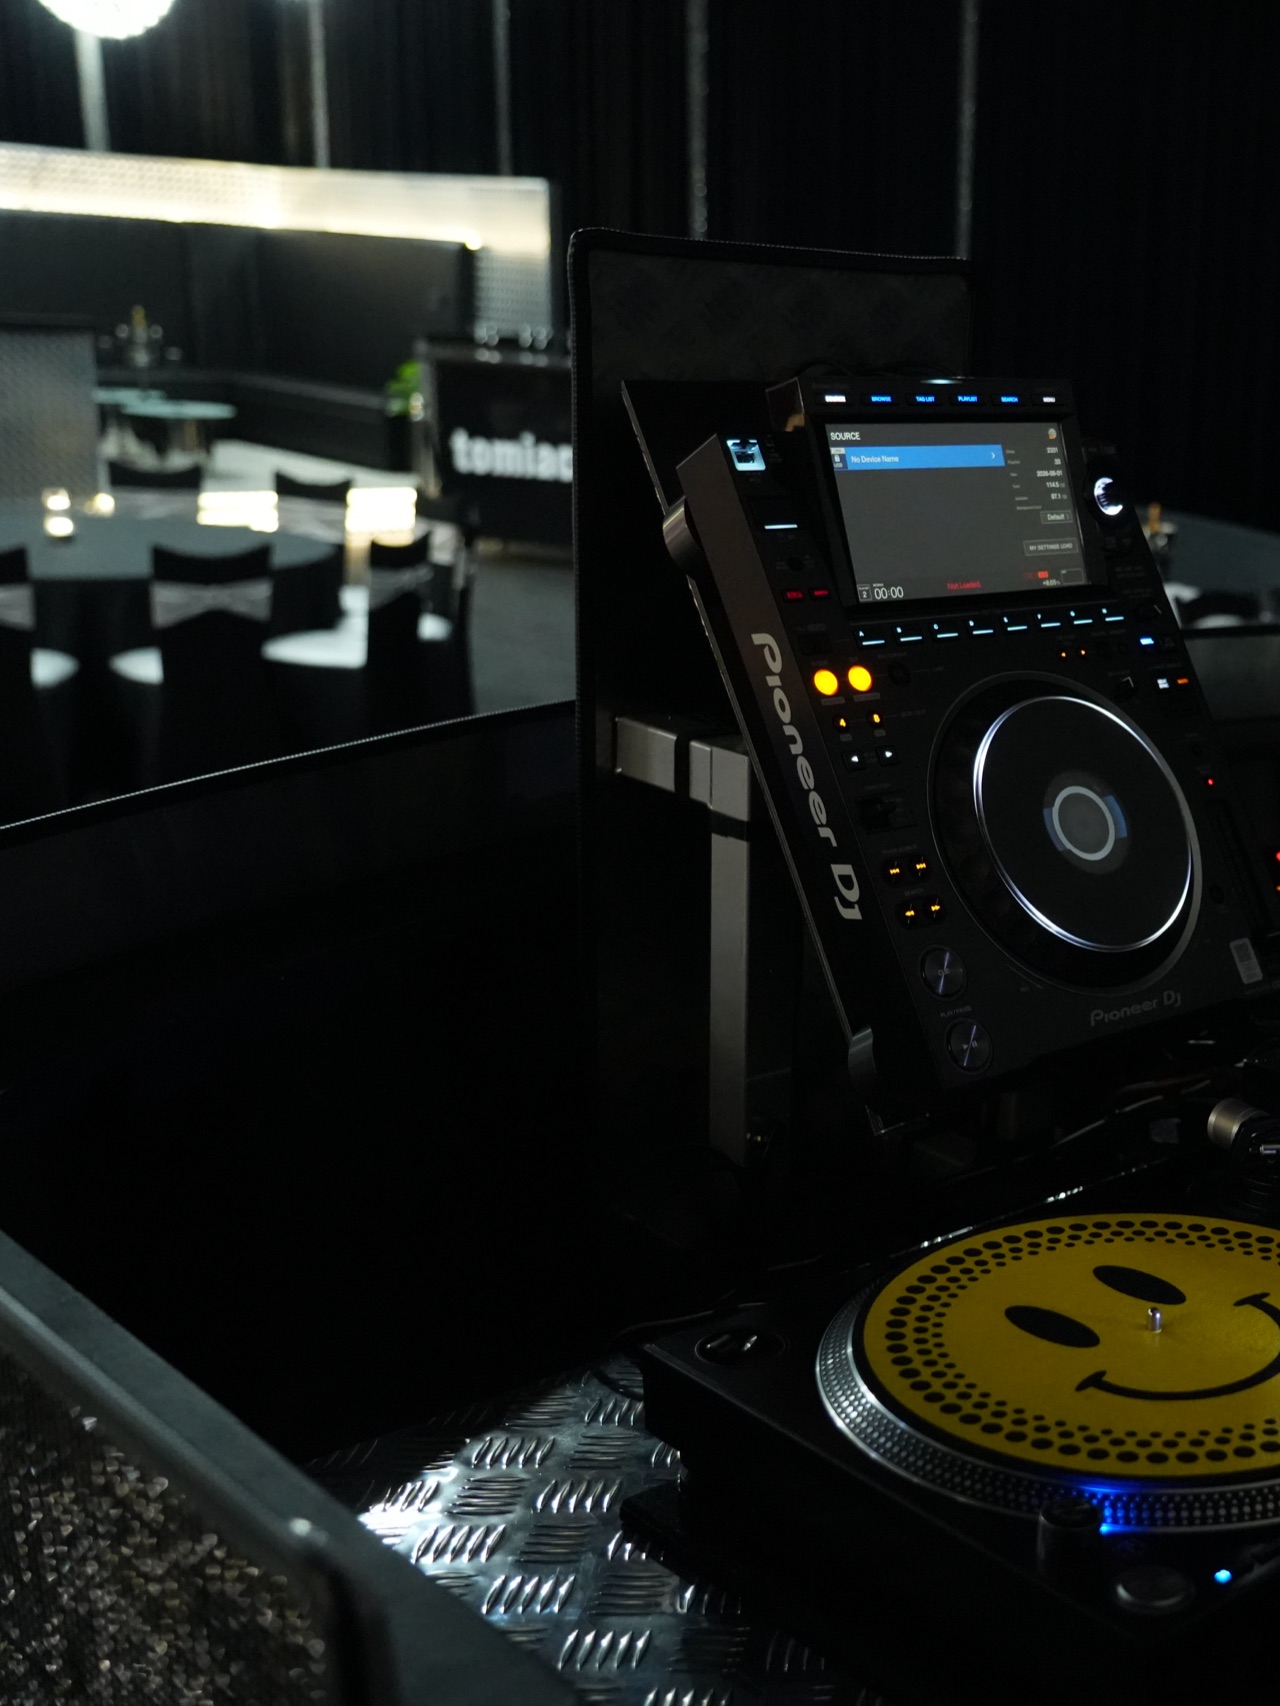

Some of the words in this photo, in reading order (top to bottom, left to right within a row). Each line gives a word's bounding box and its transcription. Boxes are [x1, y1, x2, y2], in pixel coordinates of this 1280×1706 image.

[830, 431, 861, 441] SOURCE
[850, 455, 860, 463] No
[860, 454, 881, 463] Device
[881, 454, 900, 463] Name
[874, 586, 904, 600] 00:00
[750, 632, 838, 848] Pioneer
[829, 863, 864, 921] DJ
[1089, 998, 1159, 1027] Pioneer
[1163, 989, 1182, 1008] DJ
